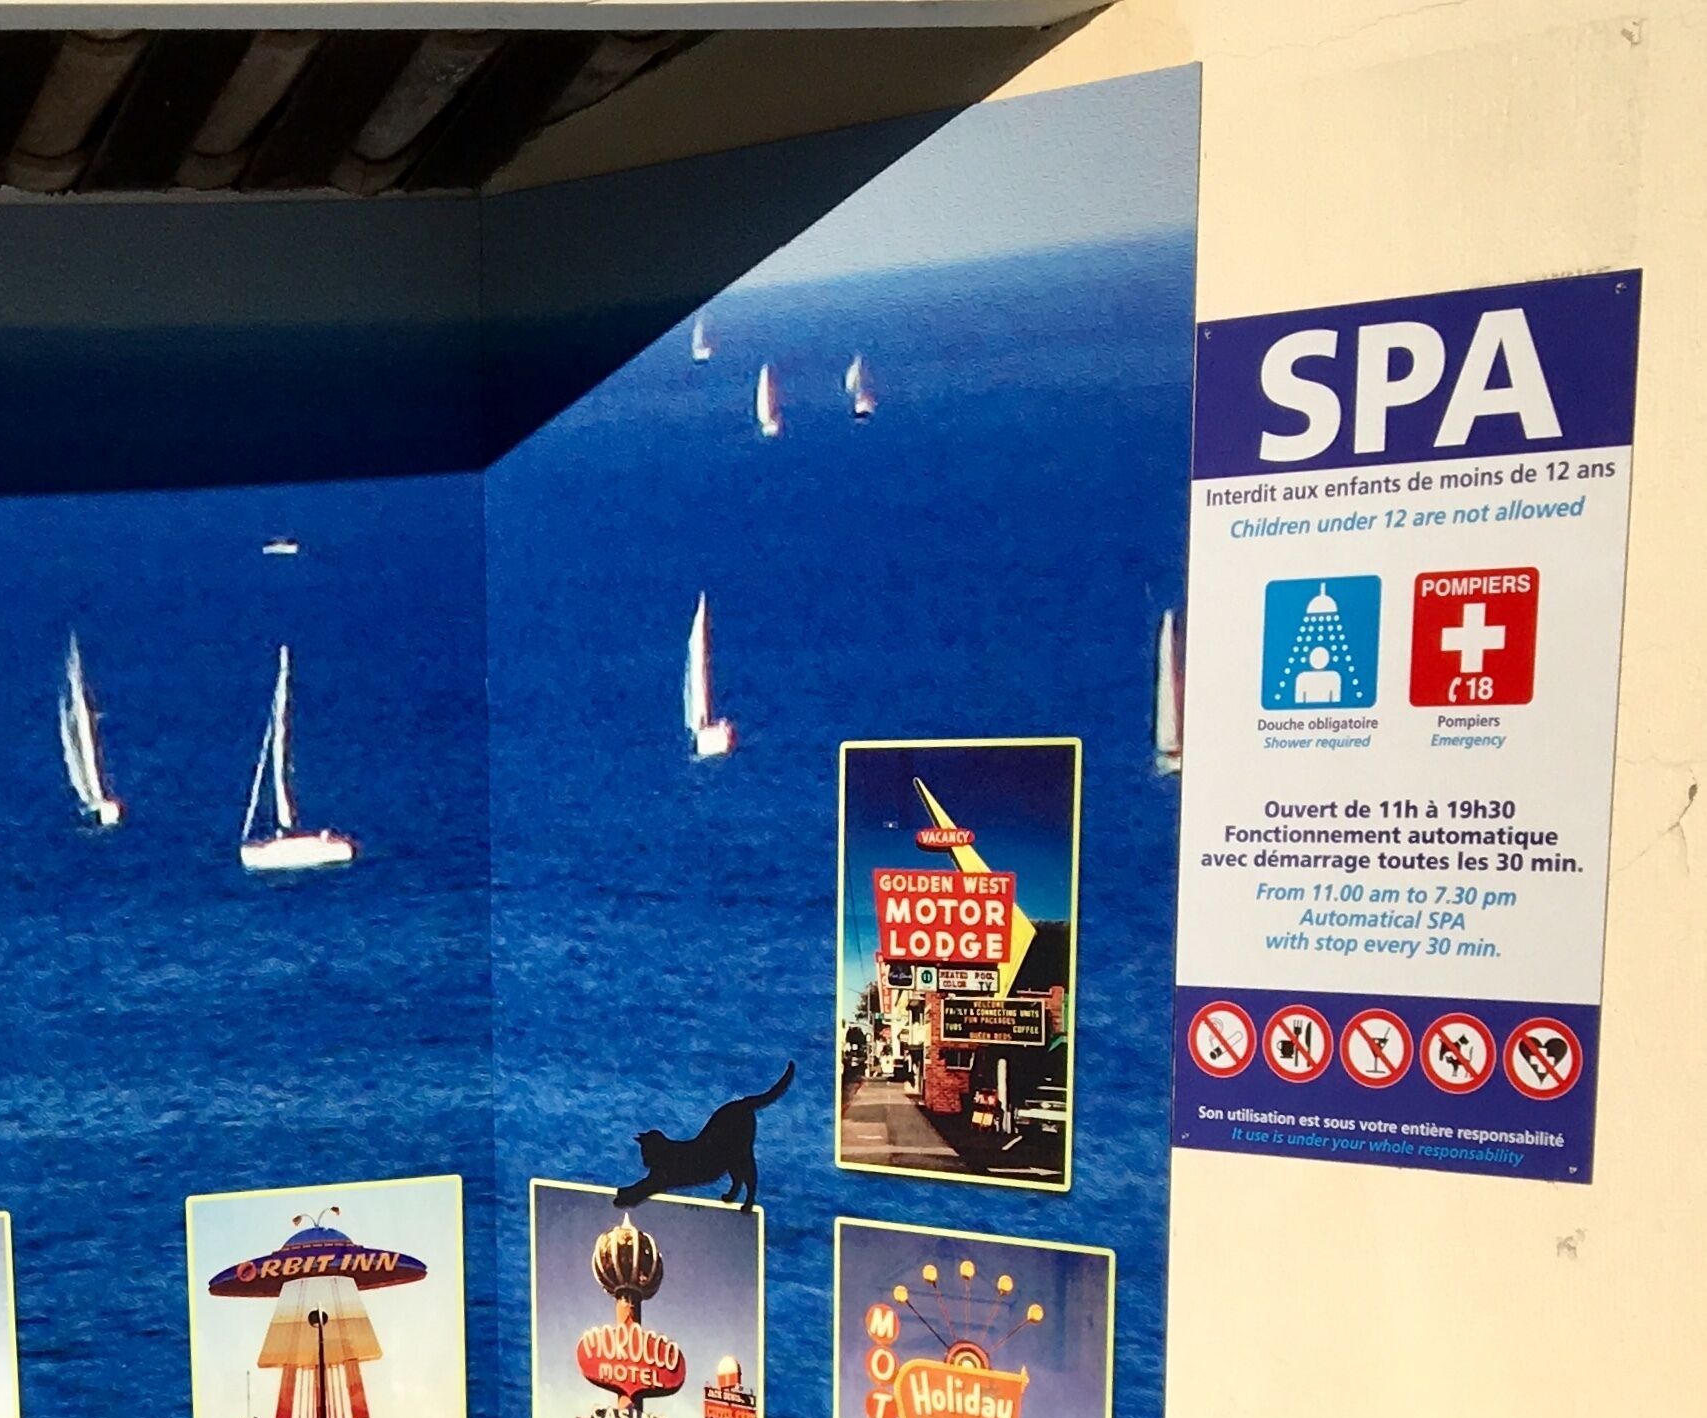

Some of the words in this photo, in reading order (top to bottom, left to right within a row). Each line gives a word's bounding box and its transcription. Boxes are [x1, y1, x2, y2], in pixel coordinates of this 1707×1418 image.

[1259, 307, 1563, 462] SPA
[1206, 483, 1277, 506] Interdit
[1283, 483, 1319, 502] aux
[1325, 474, 1401, 498] enfants
[1407, 471, 1433, 491] de
[1440, 466, 1504, 490] moins
[1510, 463, 1537, 485] de
[1546, 461, 1570, 482] 12
[1577, 461, 1615, 479] ans
[1230, 515, 1310, 538] Children
[1317, 511, 1377, 534] under
[1384, 509, 1407, 530] 12
[1413, 510, 1448, 528] are
[1453, 505, 1489, 524] not
[1495, 497, 1586, 521] allowed
[1421, 575, 1531, 597] POMPIERS
[1466, 678, 1494, 699] 18
[1257, 716, 1305, 731] Douche
[1308, 715, 1378, 733] obligatoire
[1437, 713, 1500, 730] Pompiers
[1263, 735, 1311, 749] Shower
[1315, 734, 1371, 750] required
[1430, 733, 1506, 749] Emergency
[1264, 800, 1337, 819] Ouvert
[1344, 800, 1371, 819] de
[1379, 800, 1418, 819] 11h
[1425, 799, 1438, 819] à
[1447, 800, 1516, 819] 19h30
[920, 831, 970, 844] VACANCY
[1224, 825, 1402, 845] Fonctionnement
[1407, 827, 1559, 849] automatique
[1201, 852, 1248, 868] avec
[1253, 849, 1371, 874] démarrage
[1378, 852, 1450, 871] toutes
[1457, 851, 1488, 871] les
[1496, 852, 1523, 871] 30
[1530, 852, 1584, 873] min.
[879, 874, 953, 893] GOLDEN
[963, 877, 1010, 894] WEST
[1256, 883, 1305, 901] From
[1312, 885, 1363, 903] 11.00
[1369, 889, 1400, 903] am
[1407, 887, 1428, 904] to
[1434, 887, 1477, 906] 7.30
[1482, 891, 1517, 910] pm
[885, 897, 1005, 926] MOTOR
[1299, 908, 1422, 929] Automatical
[1426, 912, 1466, 931] SPA
[889, 930, 1004, 959] LODGE
[1265, 932, 1310, 951] with
[1315, 935, 1359, 956] stop
[1363, 939, 1421, 959] every
[1425, 937, 1451, 956] 30
[1456, 938, 1501, 958] min.
[979, 982, 992, 991] TV
[1198, 1106, 1224, 1121] Son
[1227, 1107, 1295, 1126] utilisation
[1299, 1113, 1321, 1127] est
[1323, 1115, 1356, 1130] sous
[1359, 1119, 1397, 1133] votre
[1401, 1121, 1454, 1138] entière
[1457, 1124, 1565, 1148] responsabilité
[1232, 1127, 1246, 1141] It
[1249, 1131, 1268, 1143] use
[1271, 1130, 1284, 1144] is
[1287, 1131, 1329, 1149] under
[1331, 1137, 1366, 1152] your
[1368, 1135, 1414, 1155] whole
[1417, 1141, 1524, 1166] responsability
[236, 1254, 335, 1282] ORBIT
[340, 1252, 400, 1272] INN
[581, 1322, 679, 1371] MOROCCO
[599, 1362, 664, 1388] MOTEL
